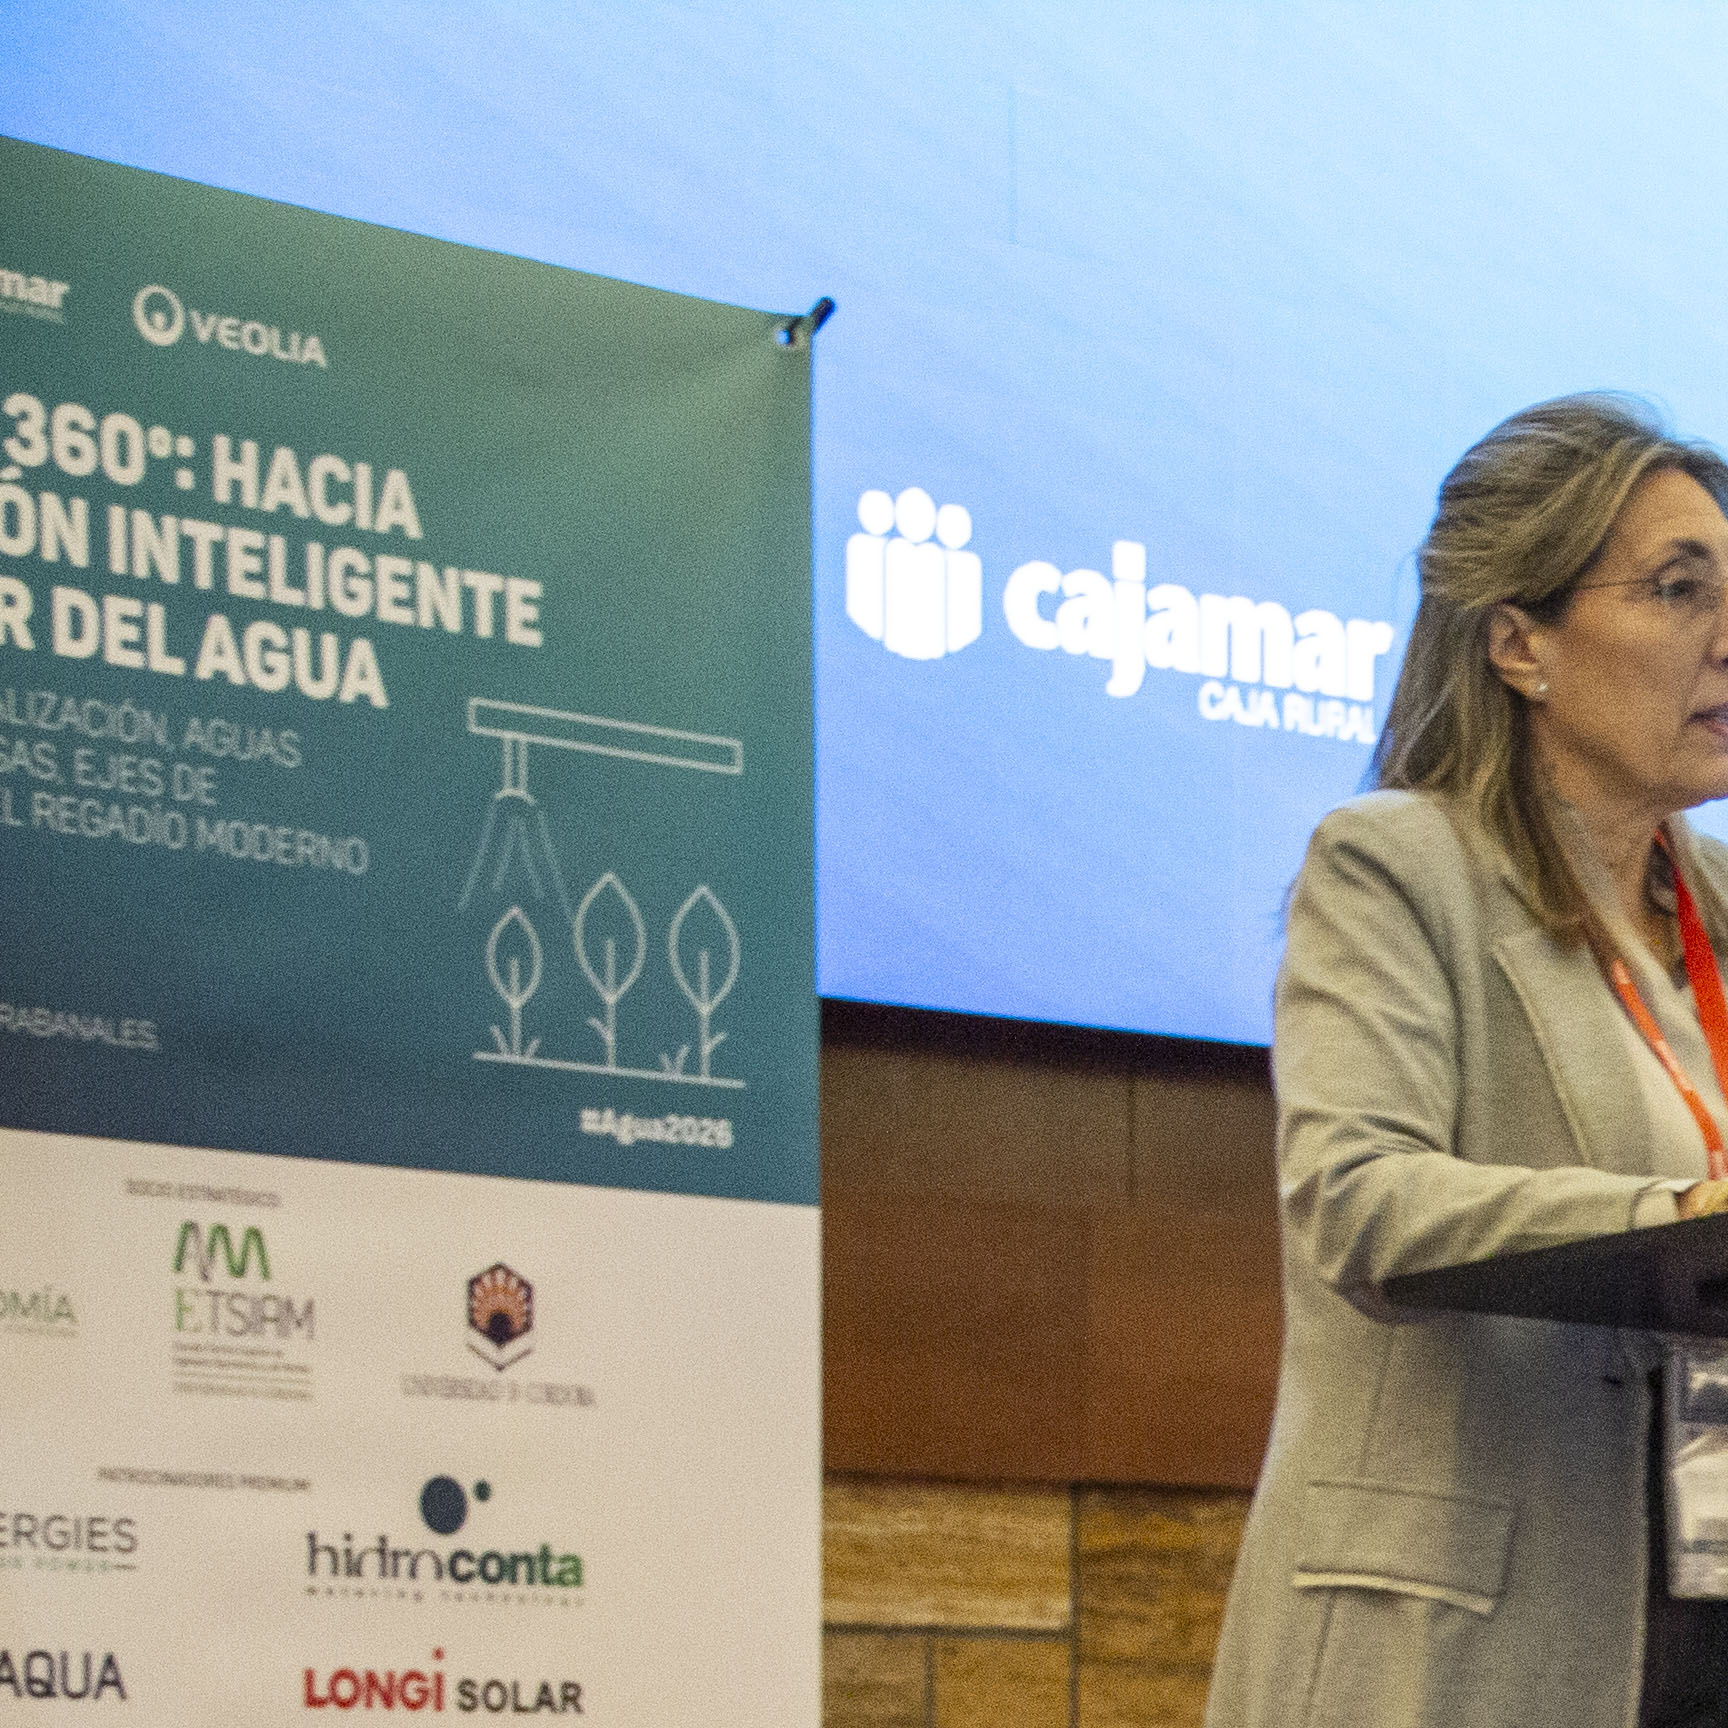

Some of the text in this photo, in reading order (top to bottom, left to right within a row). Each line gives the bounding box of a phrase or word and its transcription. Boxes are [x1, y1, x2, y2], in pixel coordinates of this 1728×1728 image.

[189, 308, 328, 370] VEOLIA
[212, 434, 423, 540] HACIA
[107, 503, 544, 649] INTELIGENTE
[51, 587, 185, 678] DEL
[196, 615, 389, 709] AGUA
[1003, 538, 1395, 701] cajamar
[182, 717, 303, 769] AGUAS
[1198, 680, 1377, 746] CAJA RURAL
[73, 748, 165, 797] EJES
[171, 762, 218, 807] DE
[31, 791, 188, 850] REGADÍO
[195, 816, 370, 876] MODERNO
[0, 1002, 159, 1052] RABANALES
[580, 1108, 733, 1149] #Agua2026
[173, 1287, 316, 1342] ETSIAM
[305, 1531, 585, 1588] hidroconta
[456, 1678, 585, 1715] SOLAR
